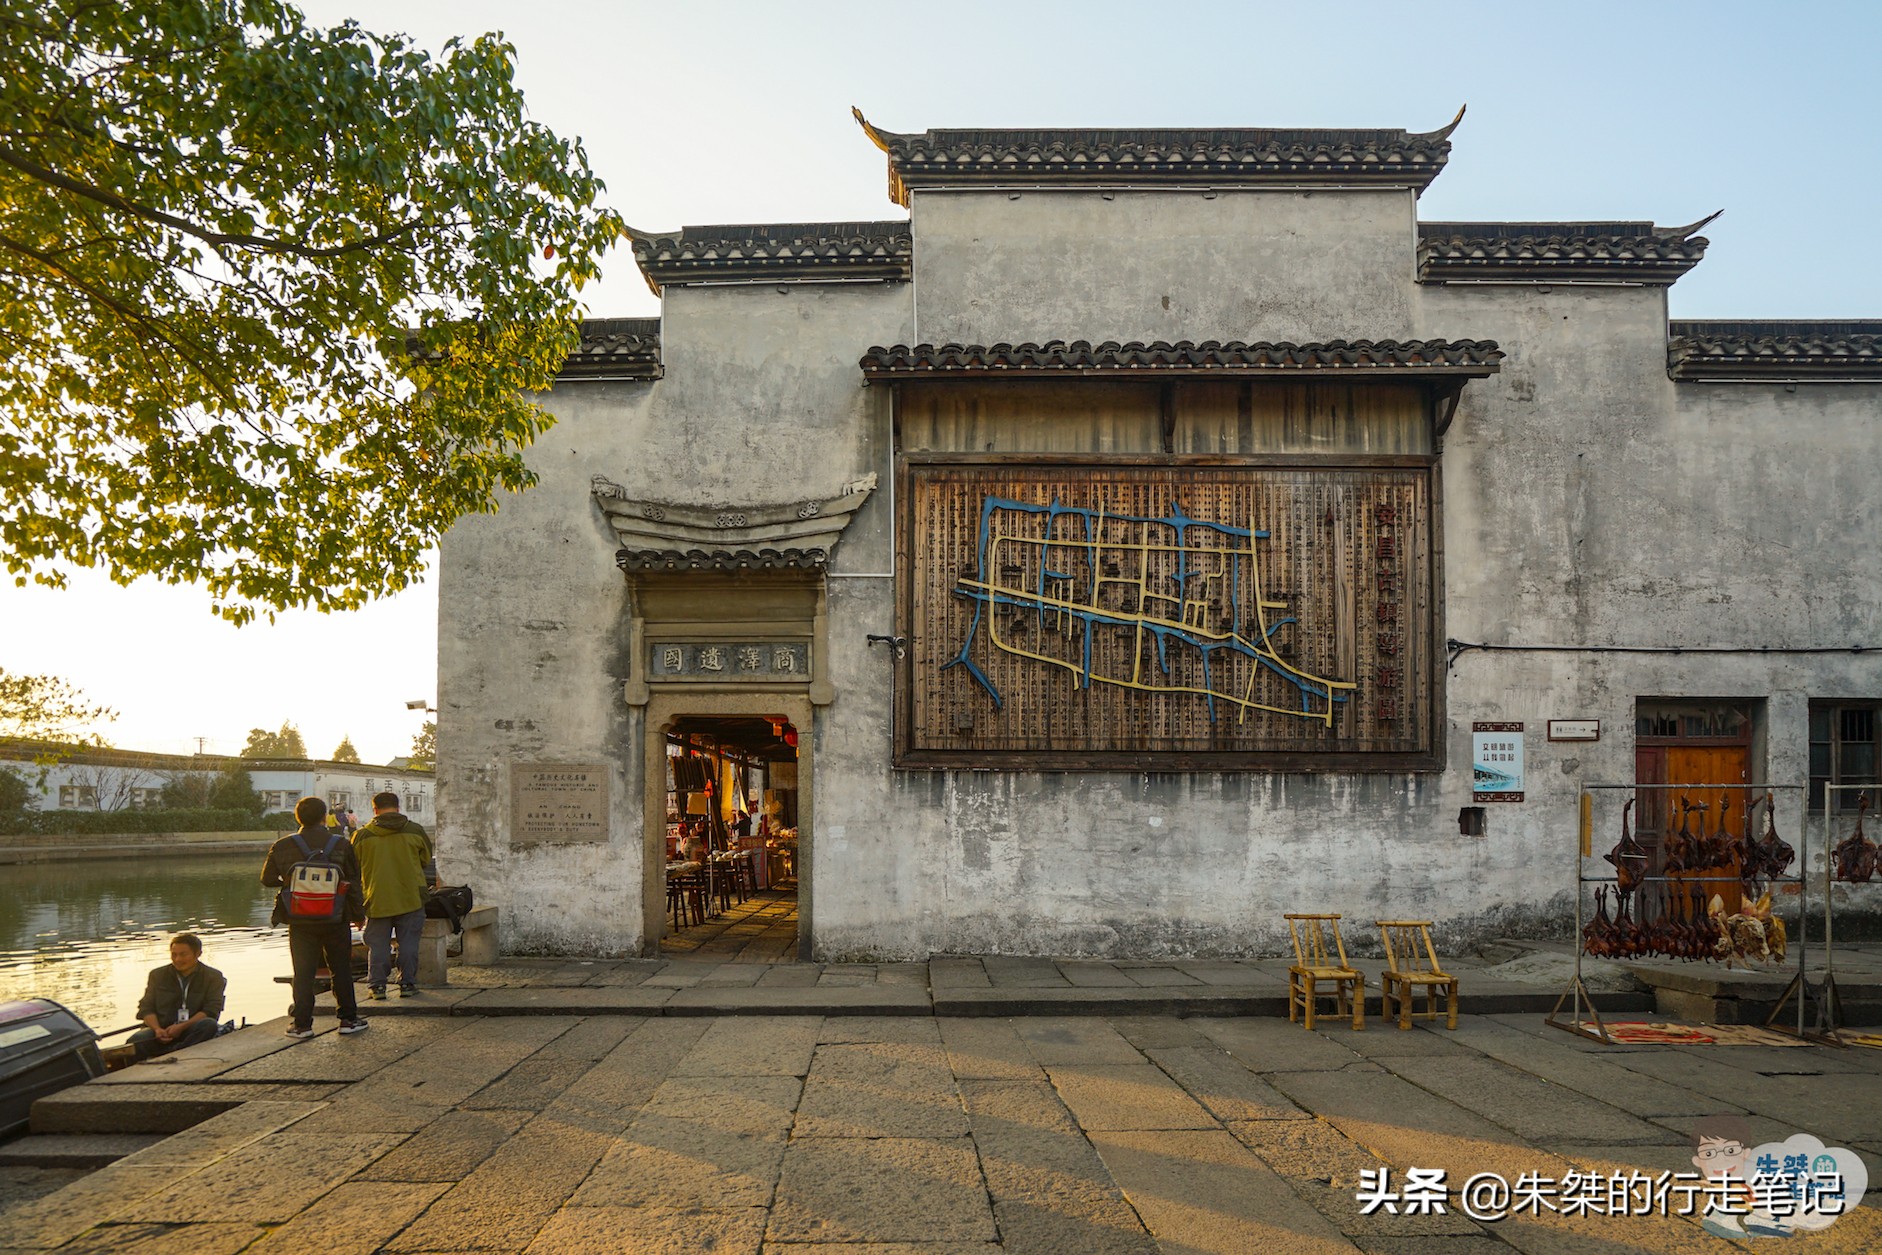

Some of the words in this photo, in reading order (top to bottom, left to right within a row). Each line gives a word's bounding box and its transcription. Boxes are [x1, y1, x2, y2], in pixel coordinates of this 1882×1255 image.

[1483, 743, 1514, 751] 文明旅游
[1483, 753, 1514, 761] 从我做起
